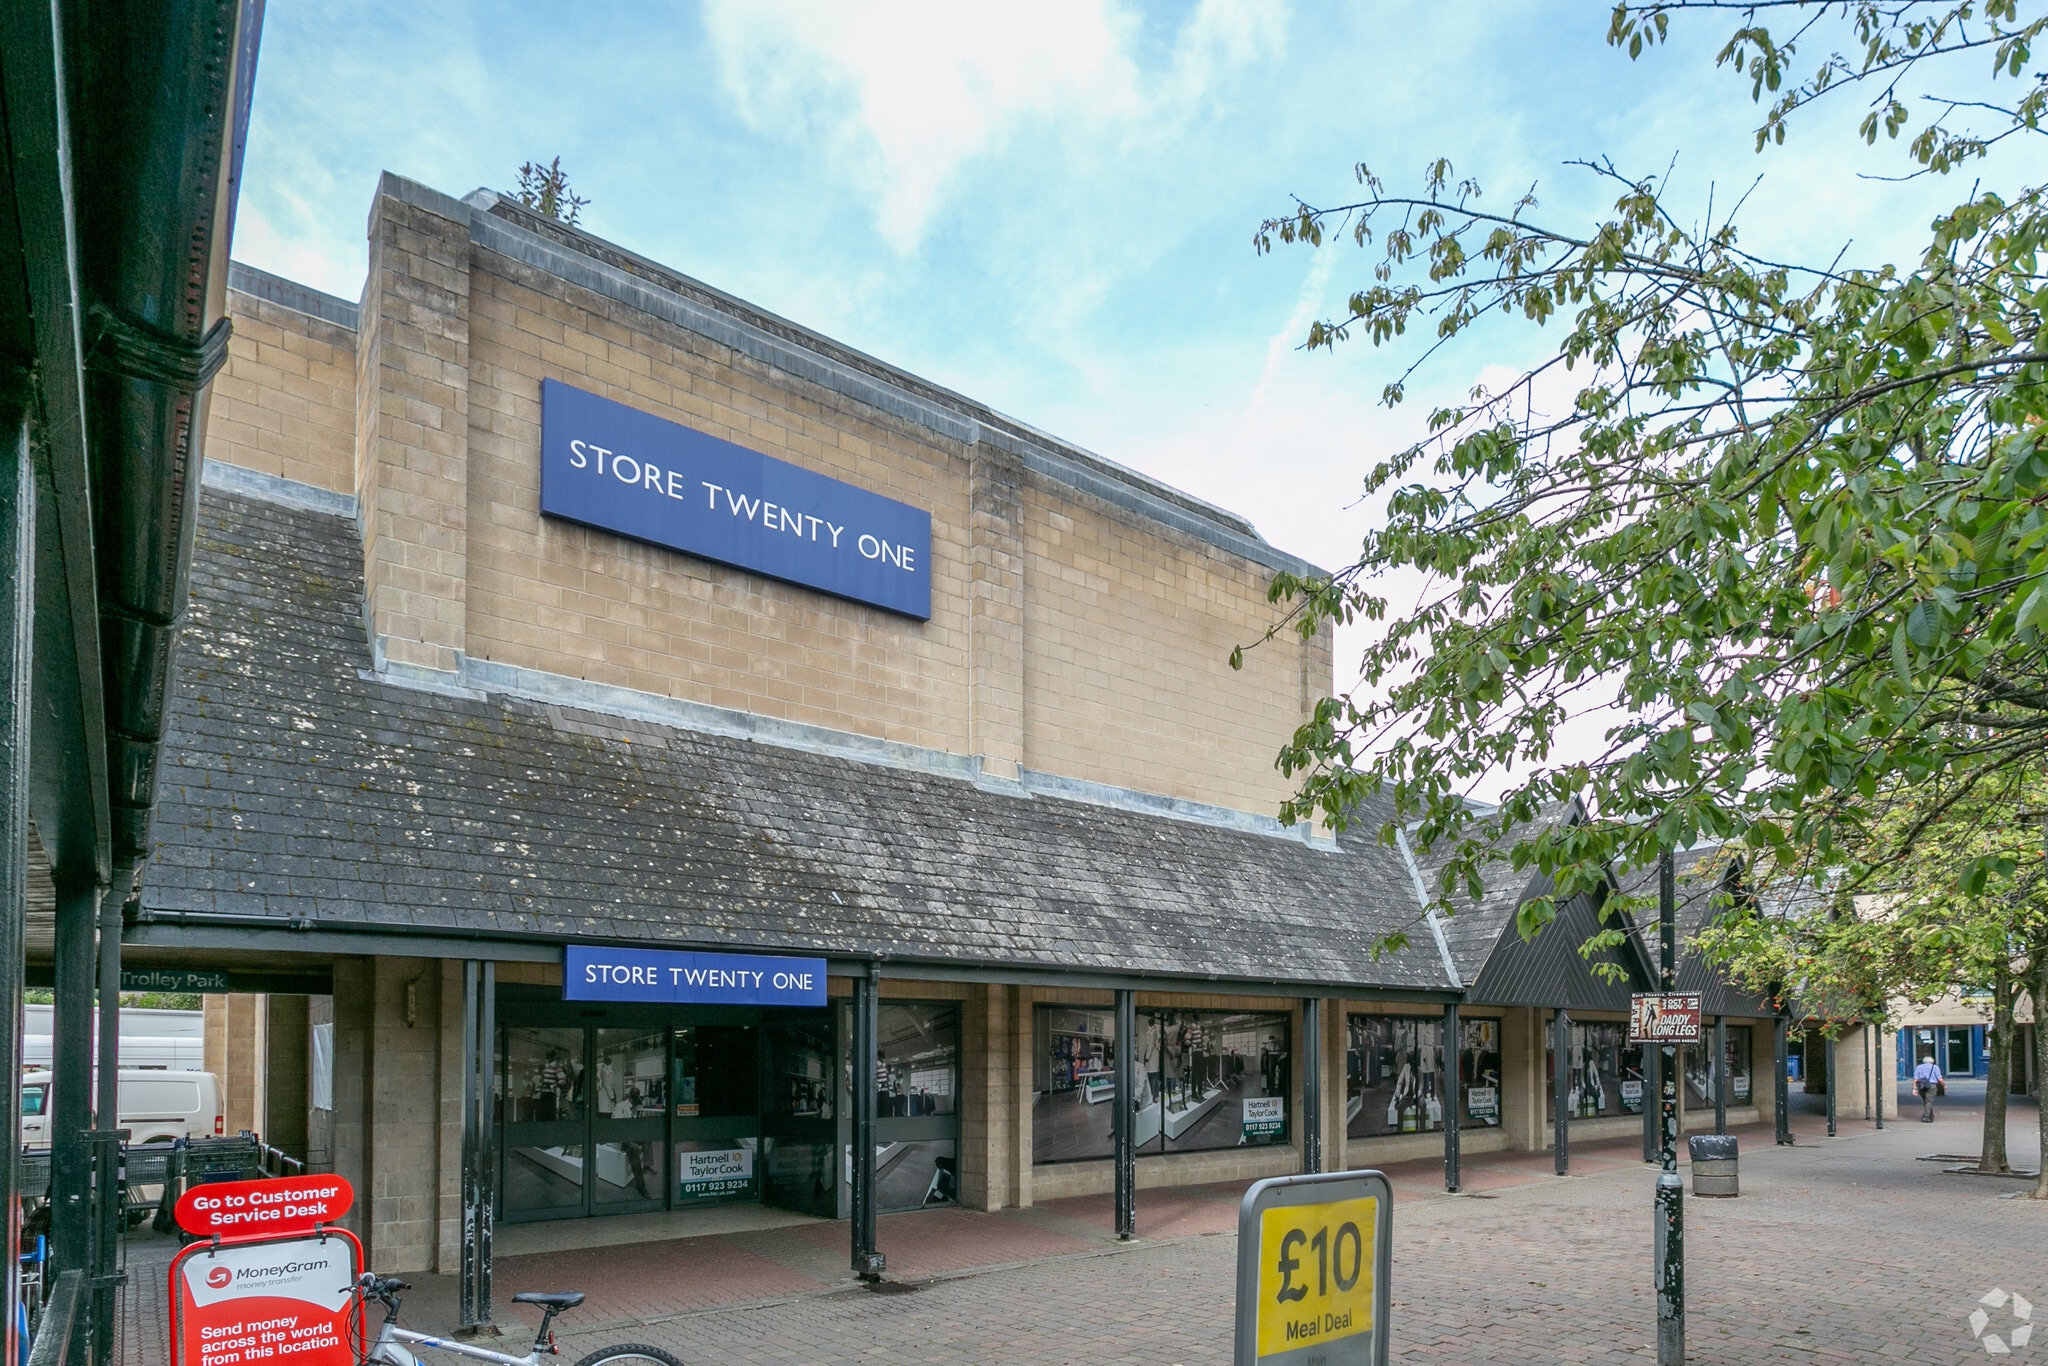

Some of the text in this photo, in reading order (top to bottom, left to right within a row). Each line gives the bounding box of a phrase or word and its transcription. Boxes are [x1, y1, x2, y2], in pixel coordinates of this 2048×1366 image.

[570, 439, 915, 572] STORE TWENTY ONE
[120, 971, 225, 989] Trolley Park
[585, 964, 813, 991] STORE TWENTY ONE
[1660, 1014, 1691, 1025] DADDY
[1652, 1025, 1698, 1036] LONG LEGS
[1248, 1101, 1270, 1109] Hartnell
[1248, 1108, 1278, 1118] Taylor Cook
[690, 1153, 729, 1165] Hartnell
[689, 1163, 744, 1177] Taylor Cook
[685, 1180, 748, 1192] 0117 923 9234
[193, 1186, 339, 1211] Go to Customer
[210, 1202, 328, 1226] Service Desk
[236, 1259, 328, 1280] MoneyGram
[1277, 1221, 1362, 1304] £10
[236, 1275, 303, 1290] money transfer
[201, 1316, 299, 1340] Send money
[1286, 1308, 1352, 1341] Meal Deal
[201, 1322, 333, 1354] across the world
[201, 1335, 339, 1366] from this location
